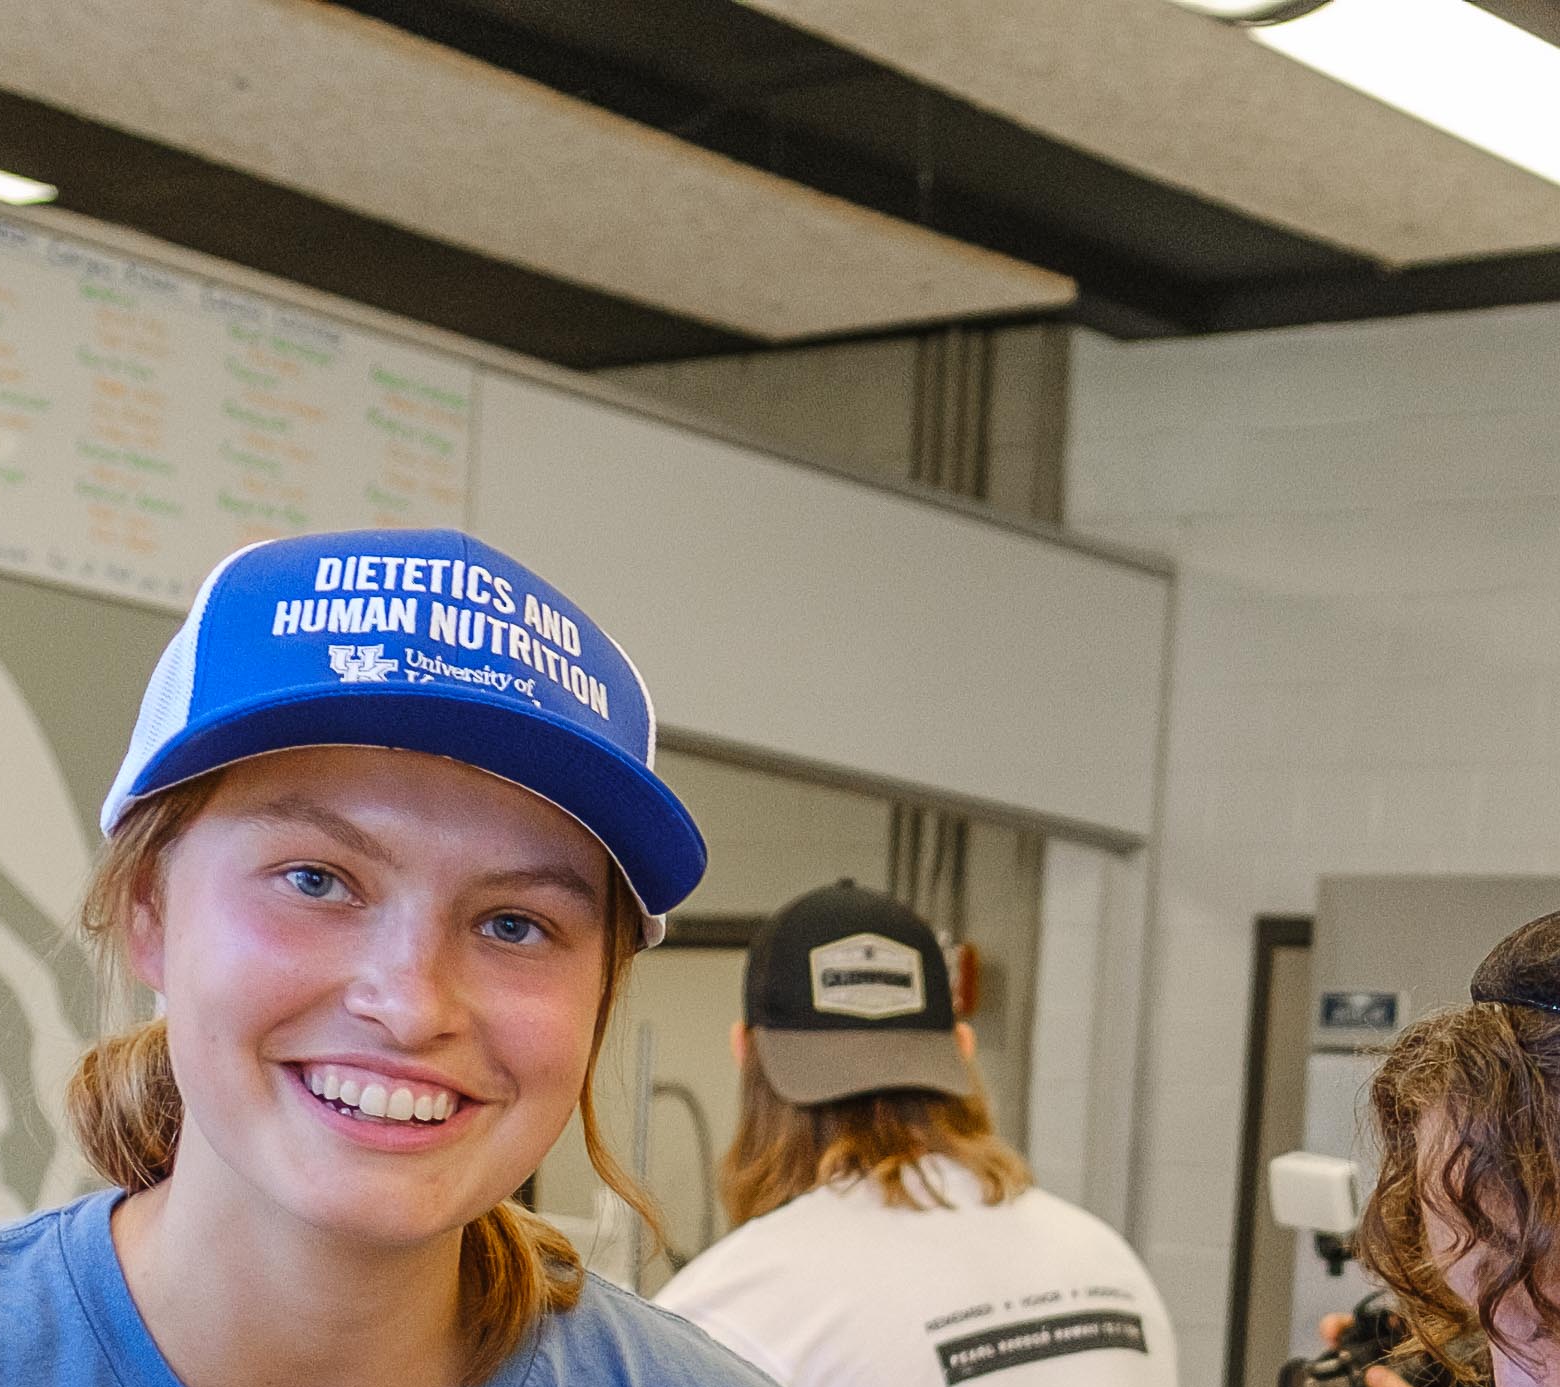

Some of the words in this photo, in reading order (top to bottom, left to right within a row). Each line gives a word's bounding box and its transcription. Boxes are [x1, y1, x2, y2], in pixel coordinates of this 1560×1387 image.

[315, 556, 516, 615] DIETETICS
[524, 593, 581, 657] AND
[272, 597, 417, 637] HUMAN
[428, 601, 610, 721] NUTRITION
[404, 648, 511, 691] University
[514, 677, 536, 697] of
